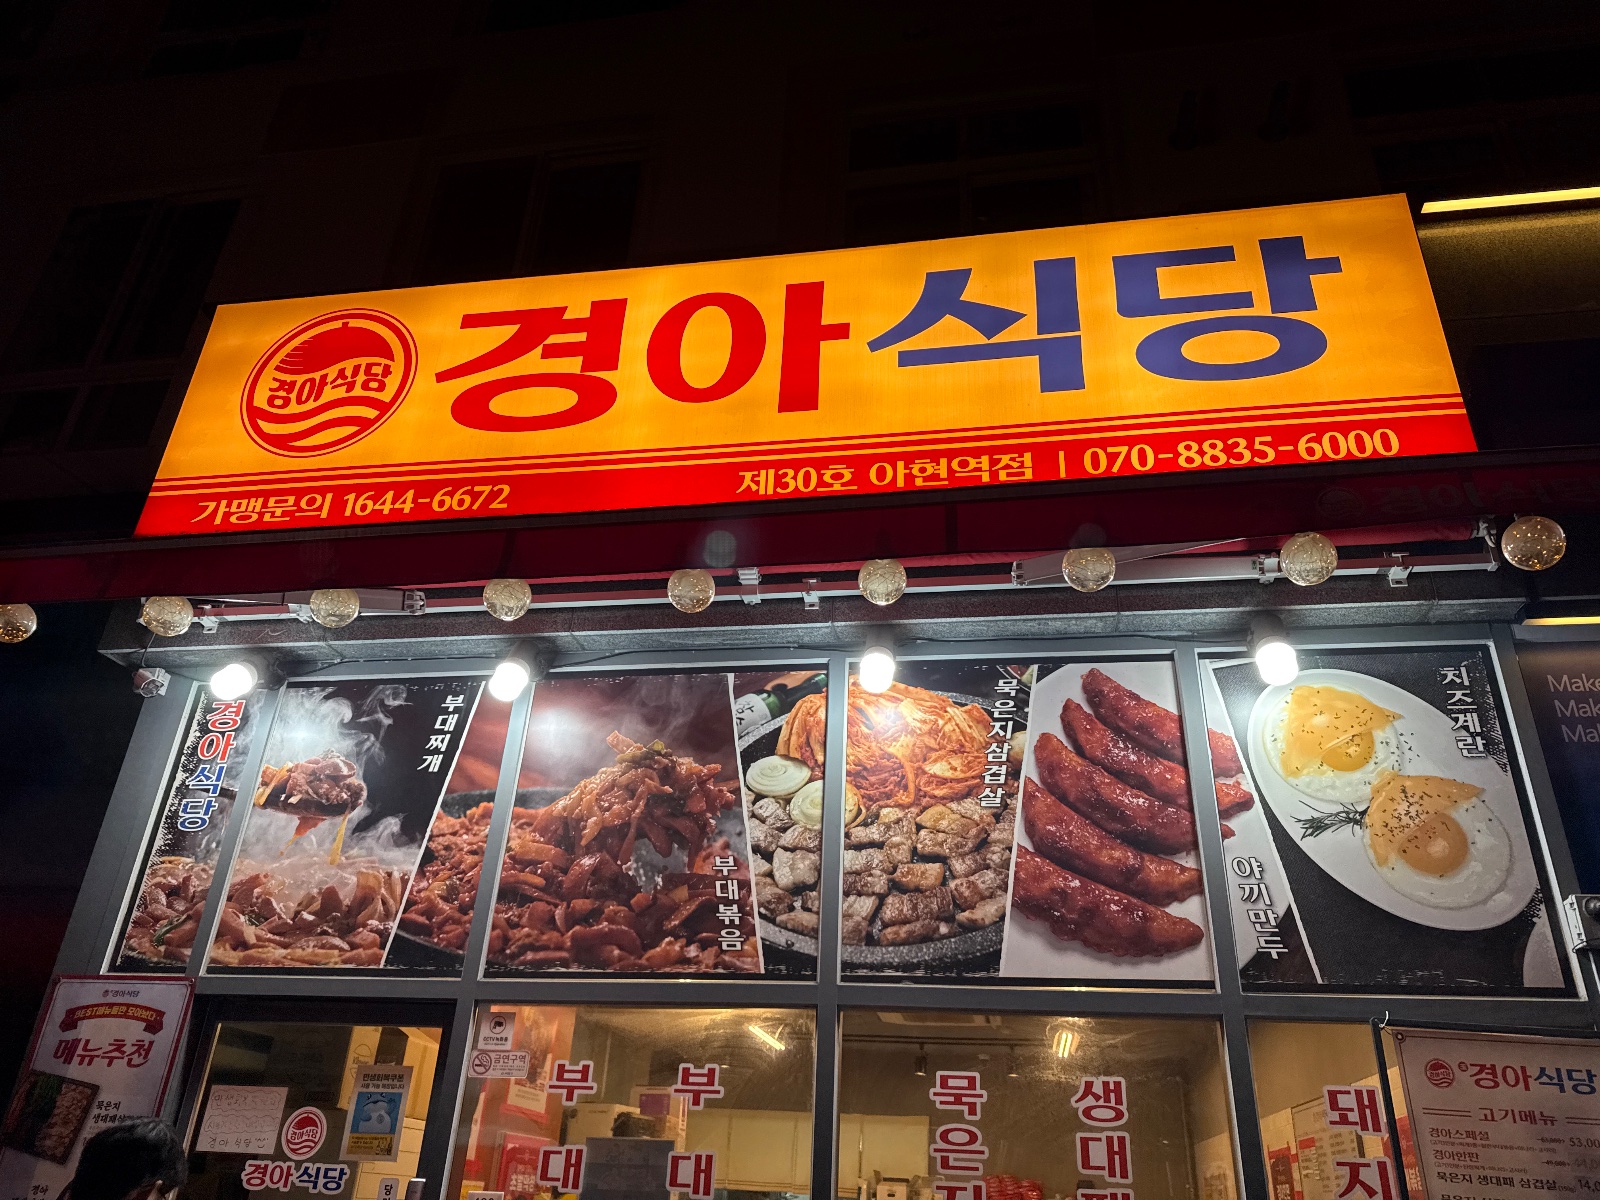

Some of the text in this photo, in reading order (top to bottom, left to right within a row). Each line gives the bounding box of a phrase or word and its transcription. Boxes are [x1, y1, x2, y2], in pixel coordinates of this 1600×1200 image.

[435, 236, 1343, 432] 경아식당
[266, 361, 393, 410] 경아식당
[736, 428, 1400, 496] 제30호 아현역점 070-8835-6000
[190, 484, 511, 526] 가맹문의 1644-6672
[1440, 666, 1487, 759] 치즈계란
[416, 694, 465, 773] 부대찌개
[177, 699, 246, 832] 경아식당
[712, 854, 745, 951] 부대볶음
[1231, 855, 1289, 959] 야끼만두
[53, 1038, 154, 1068] 메뉴추천
[493, 1053, 527, 1065] 금연구역
[1469, 1063, 1597, 1095] 경아식당
[95, 1100, 121, 1112] 묵은지
[1478, 1107, 1558, 1127] 고기메뉴
[289, 1128, 319, 1141] 경아식당
[1073, 1079, 1130, 1200] 생대
[1428, 1127, 1490, 1141] 경아스페셜
[1432, 1149, 1480, 1163] 경아한판
[244, 1163, 347, 1191] 경아식당
[1436, 1171, 1473, 1185] 묵은지
[1476, 1174, 1515, 1188] 생대패
[1518, 1177, 1558, 1191] 삼겹살
